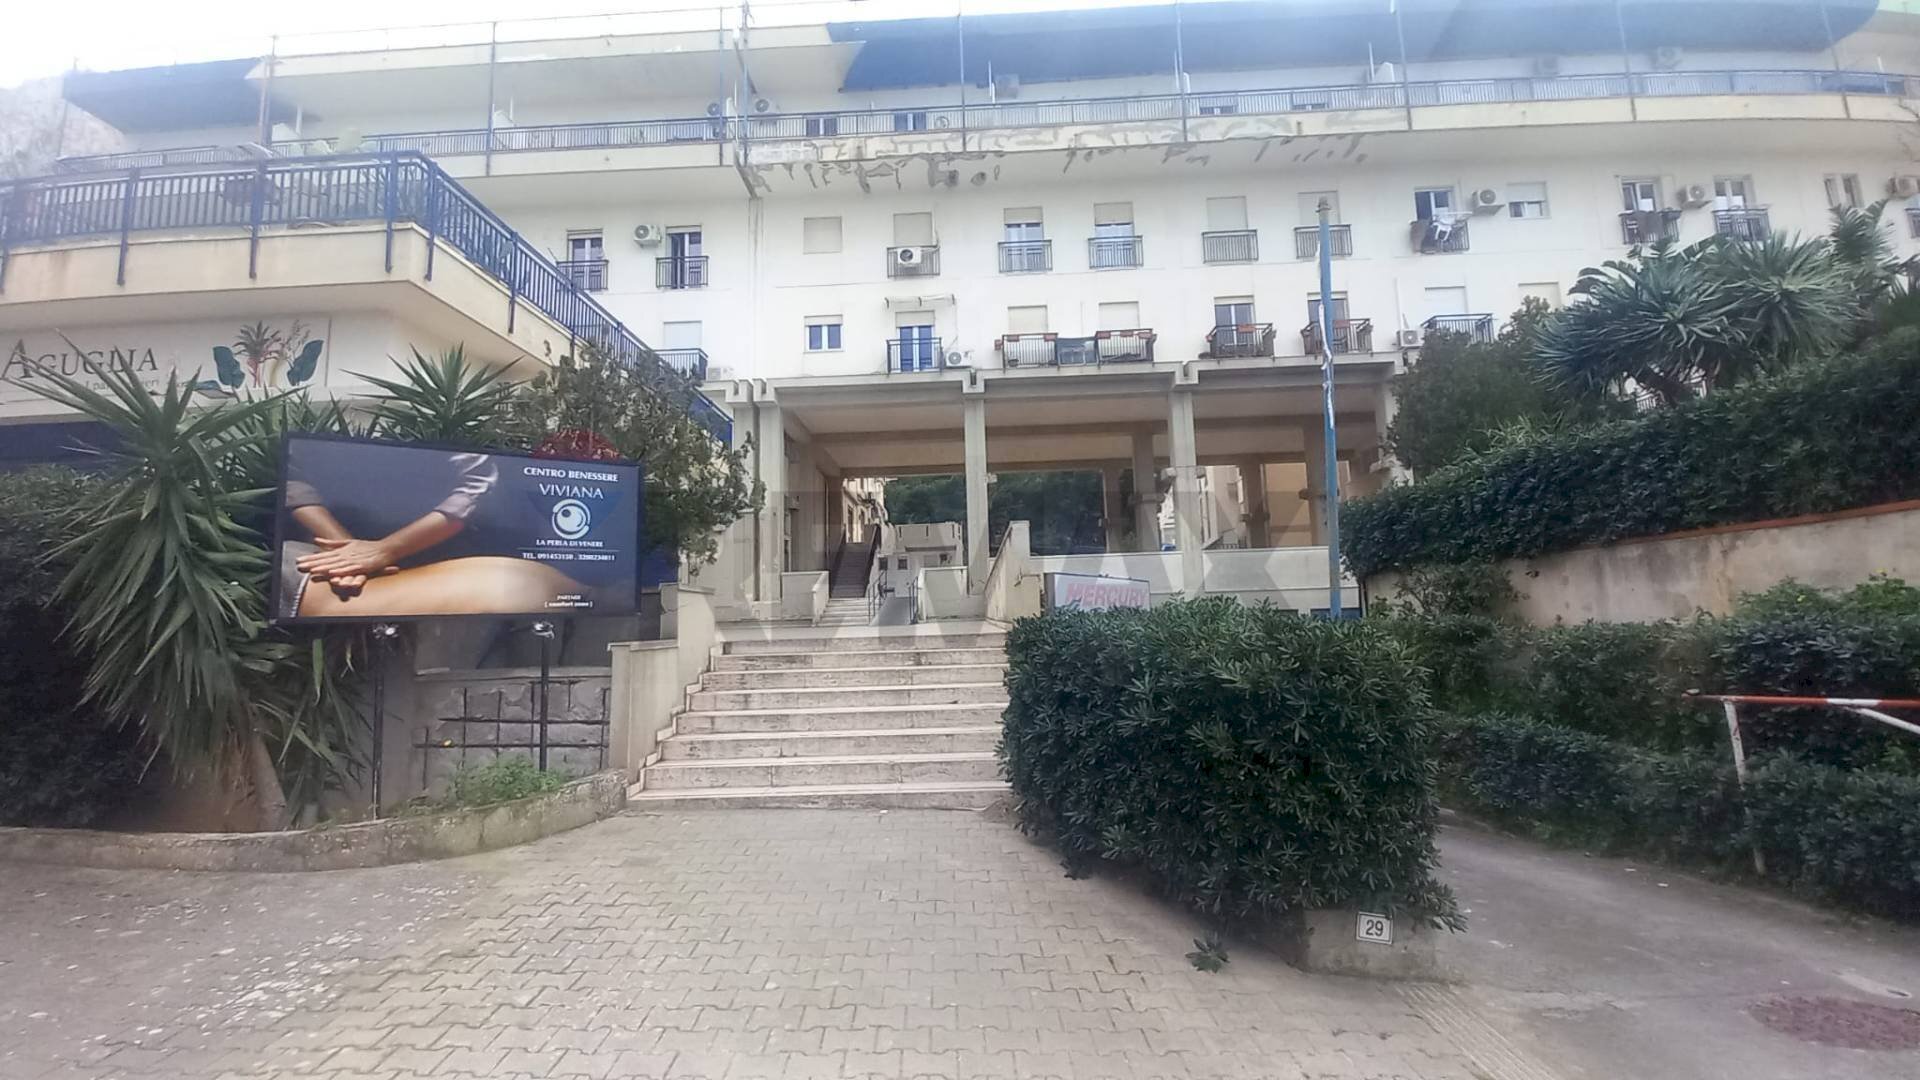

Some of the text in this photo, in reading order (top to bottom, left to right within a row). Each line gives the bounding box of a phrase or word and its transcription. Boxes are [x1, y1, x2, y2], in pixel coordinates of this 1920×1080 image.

[523, 467, 618, 482] CENTRO BENESSERE
[539, 483, 604, 499] VIVIANA
[1365, 919, 1384, 937] 29
